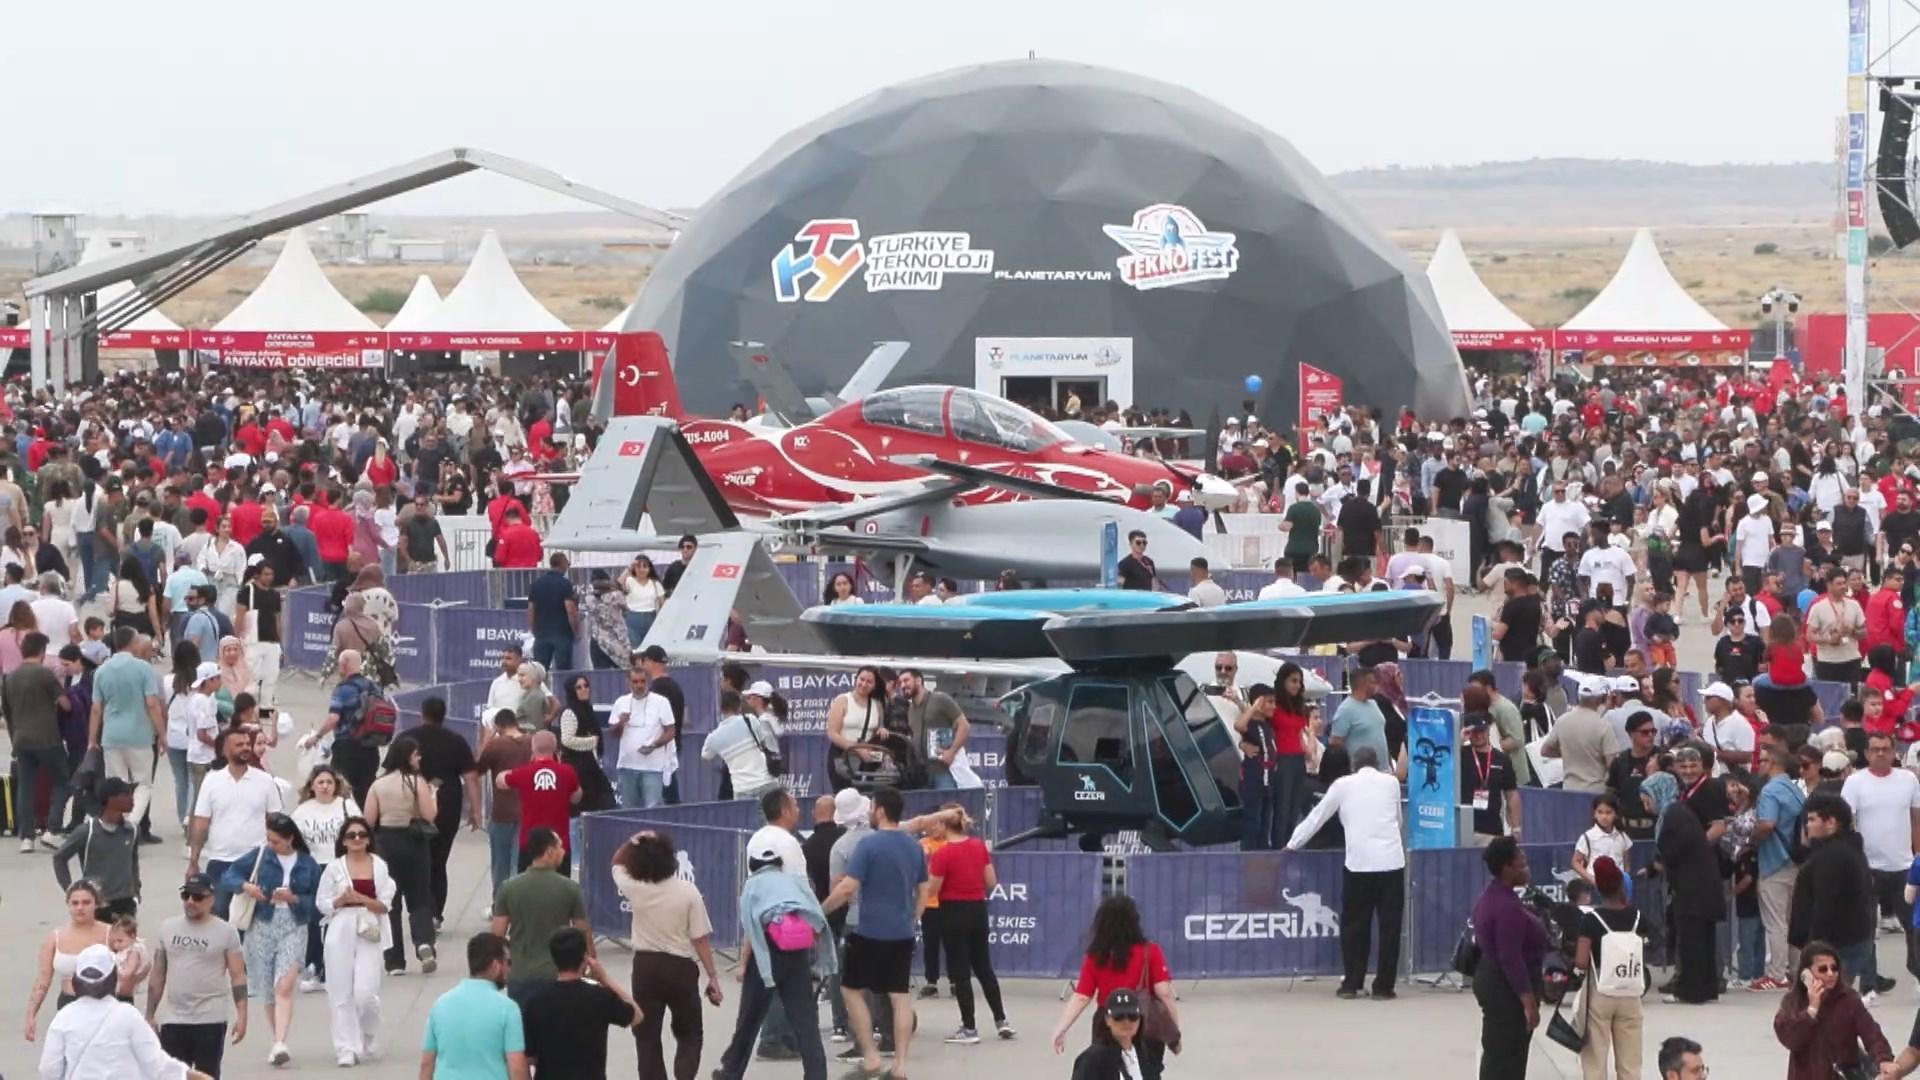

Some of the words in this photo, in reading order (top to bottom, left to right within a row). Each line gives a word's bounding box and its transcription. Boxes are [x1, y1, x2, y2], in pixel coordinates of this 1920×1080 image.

[1126, 248, 1236, 281] TEKNOFEST
[869, 270, 938, 288] TAKIMI
[994, 269, 1112, 281] PLANETARYUM
[265, 333, 314, 341] ANTAKYA
[449, 336, 479, 345] MEGA
[224, 354, 284, 367] ANTAKYA
[287, 352, 360, 367] DÖNERCİSİ
[1009, 352, 1089, 361] PLANETARYUM
[1225, 588, 1254, 600] KAR
[313, 612, 334, 625] BAYK
[487, 628, 522, 640] BAYK
[997, 916, 1037, 928] SKIES
[172, 935, 209, 948] BOSS
[1000, 932, 1030, 944] CAR
